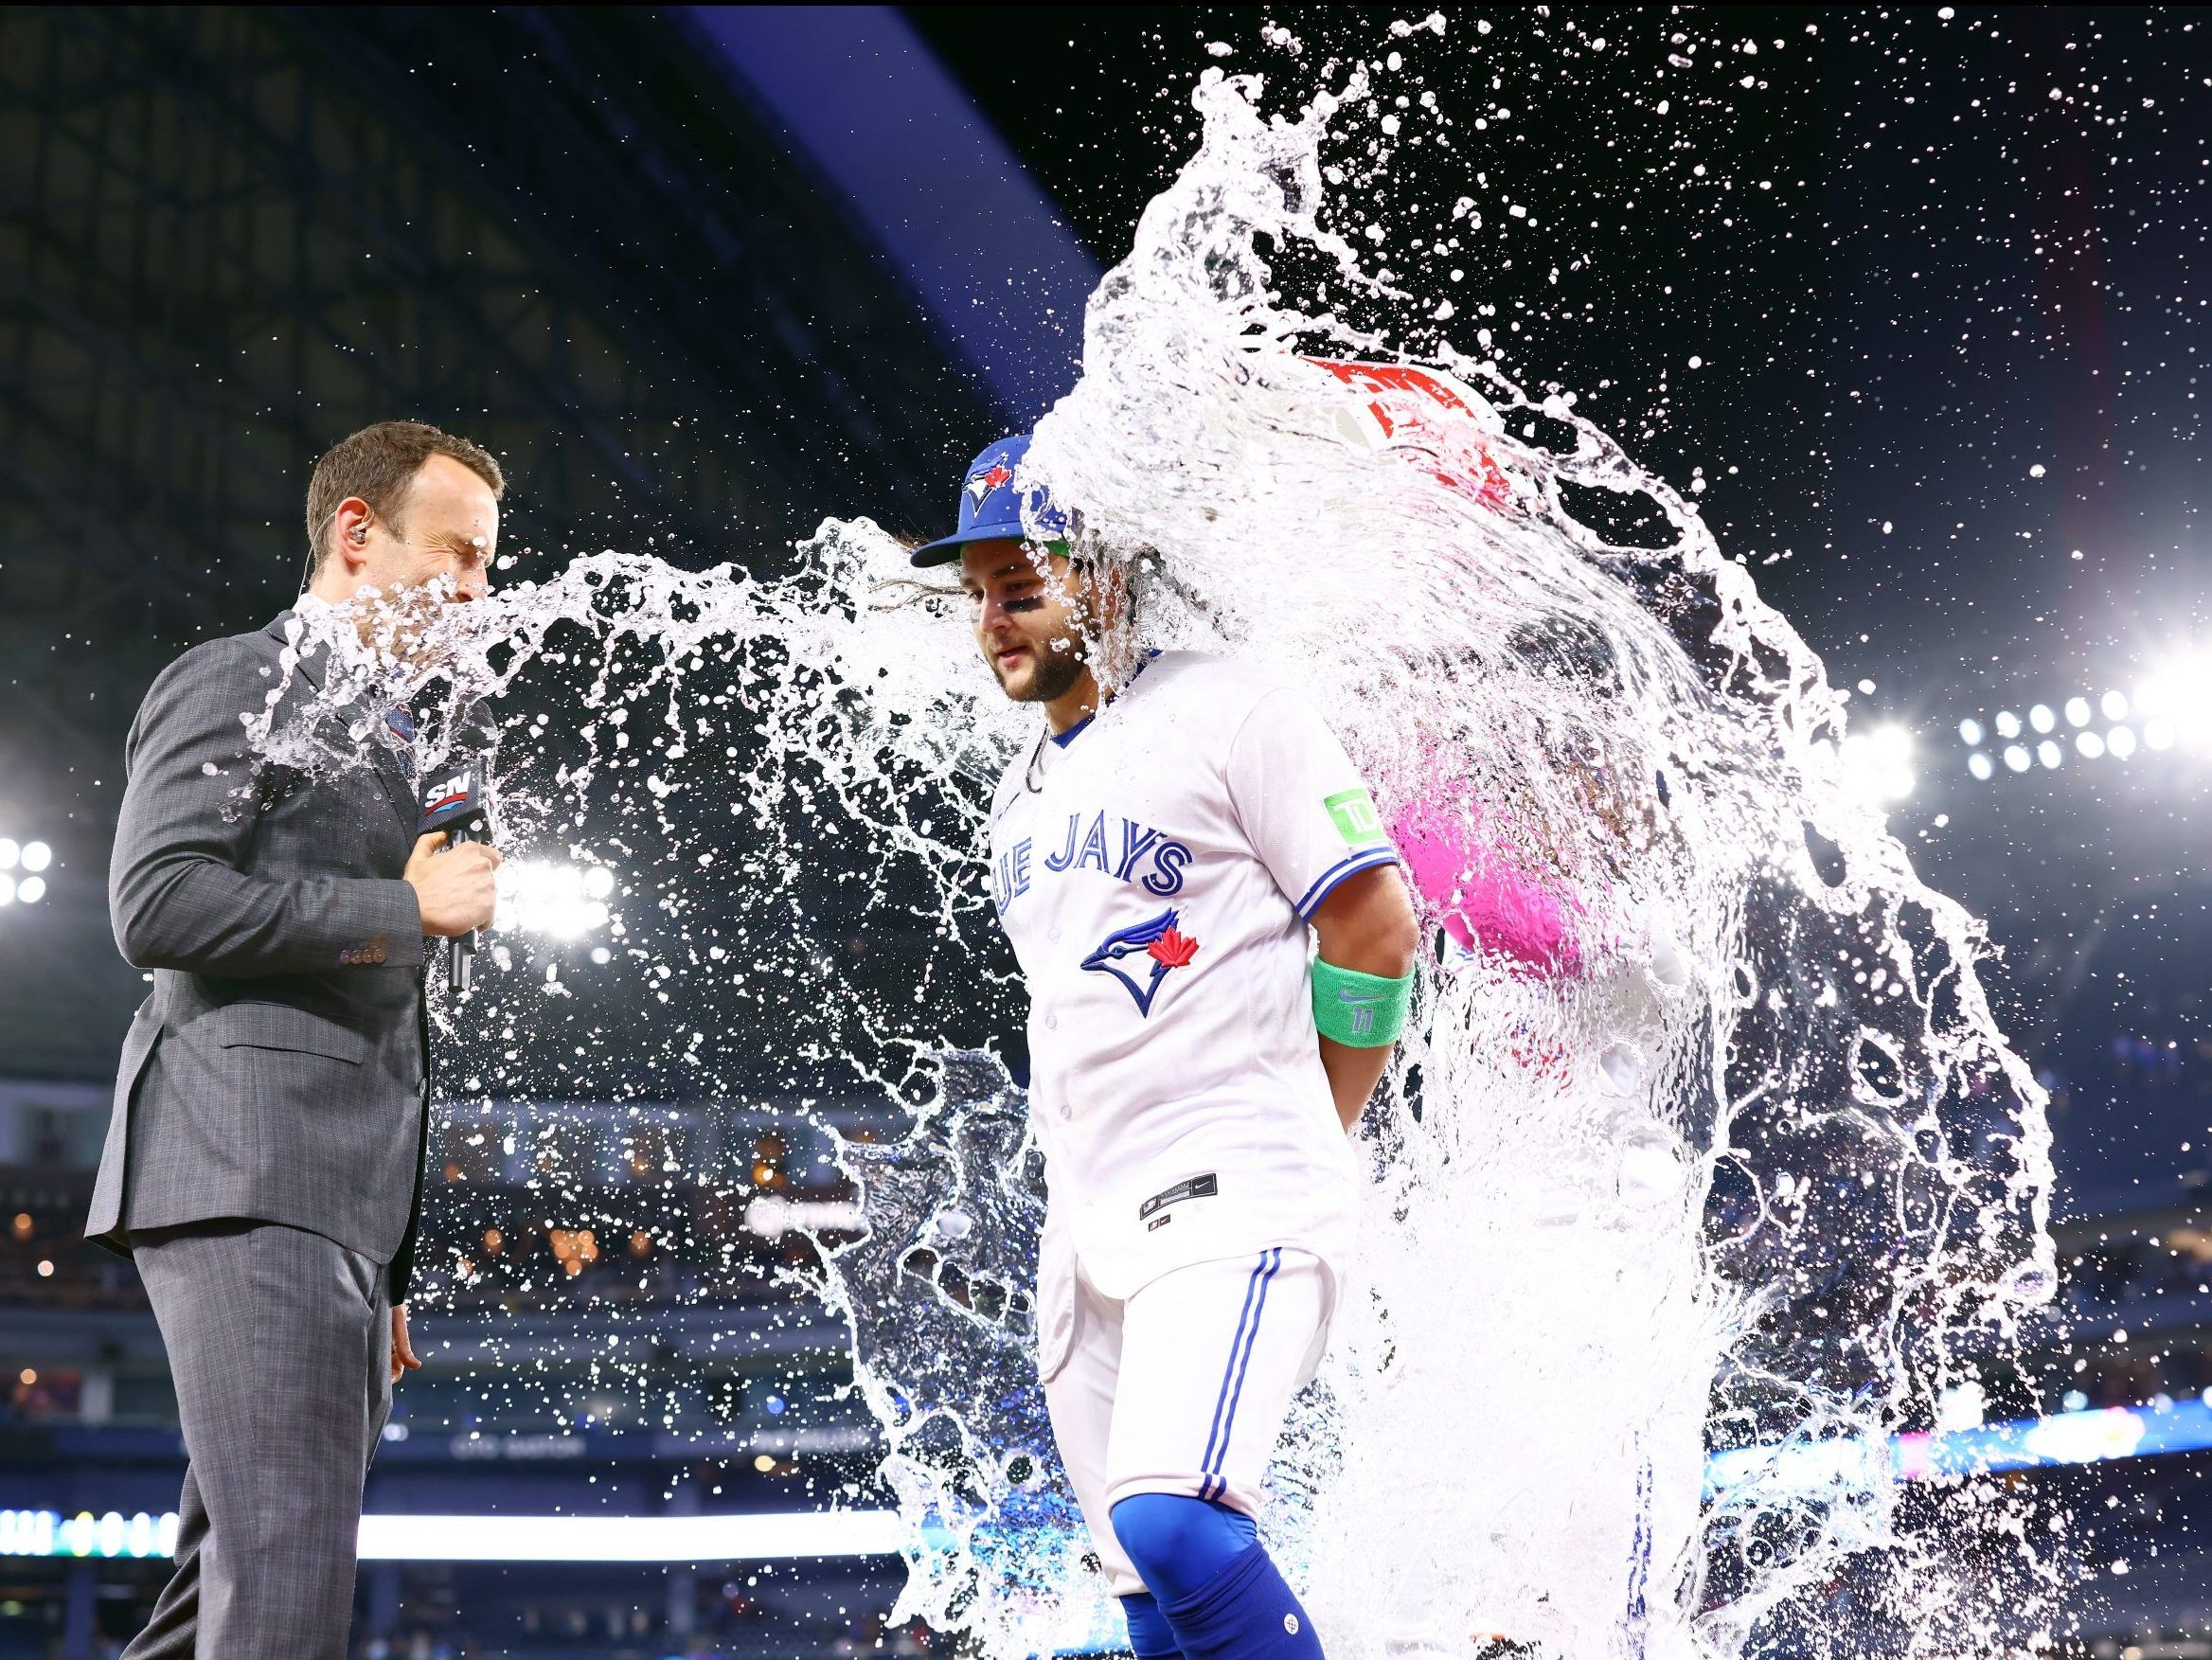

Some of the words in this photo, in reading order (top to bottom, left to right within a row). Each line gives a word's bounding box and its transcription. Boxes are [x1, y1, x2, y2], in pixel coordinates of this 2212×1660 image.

[424, 771, 472, 808] SN
[1333, 797, 1379, 833] TD
[991, 836, 1032, 917] UE
[1044, 809, 1193, 897] JAYS
[1352, 1008, 1373, 1033] 11
